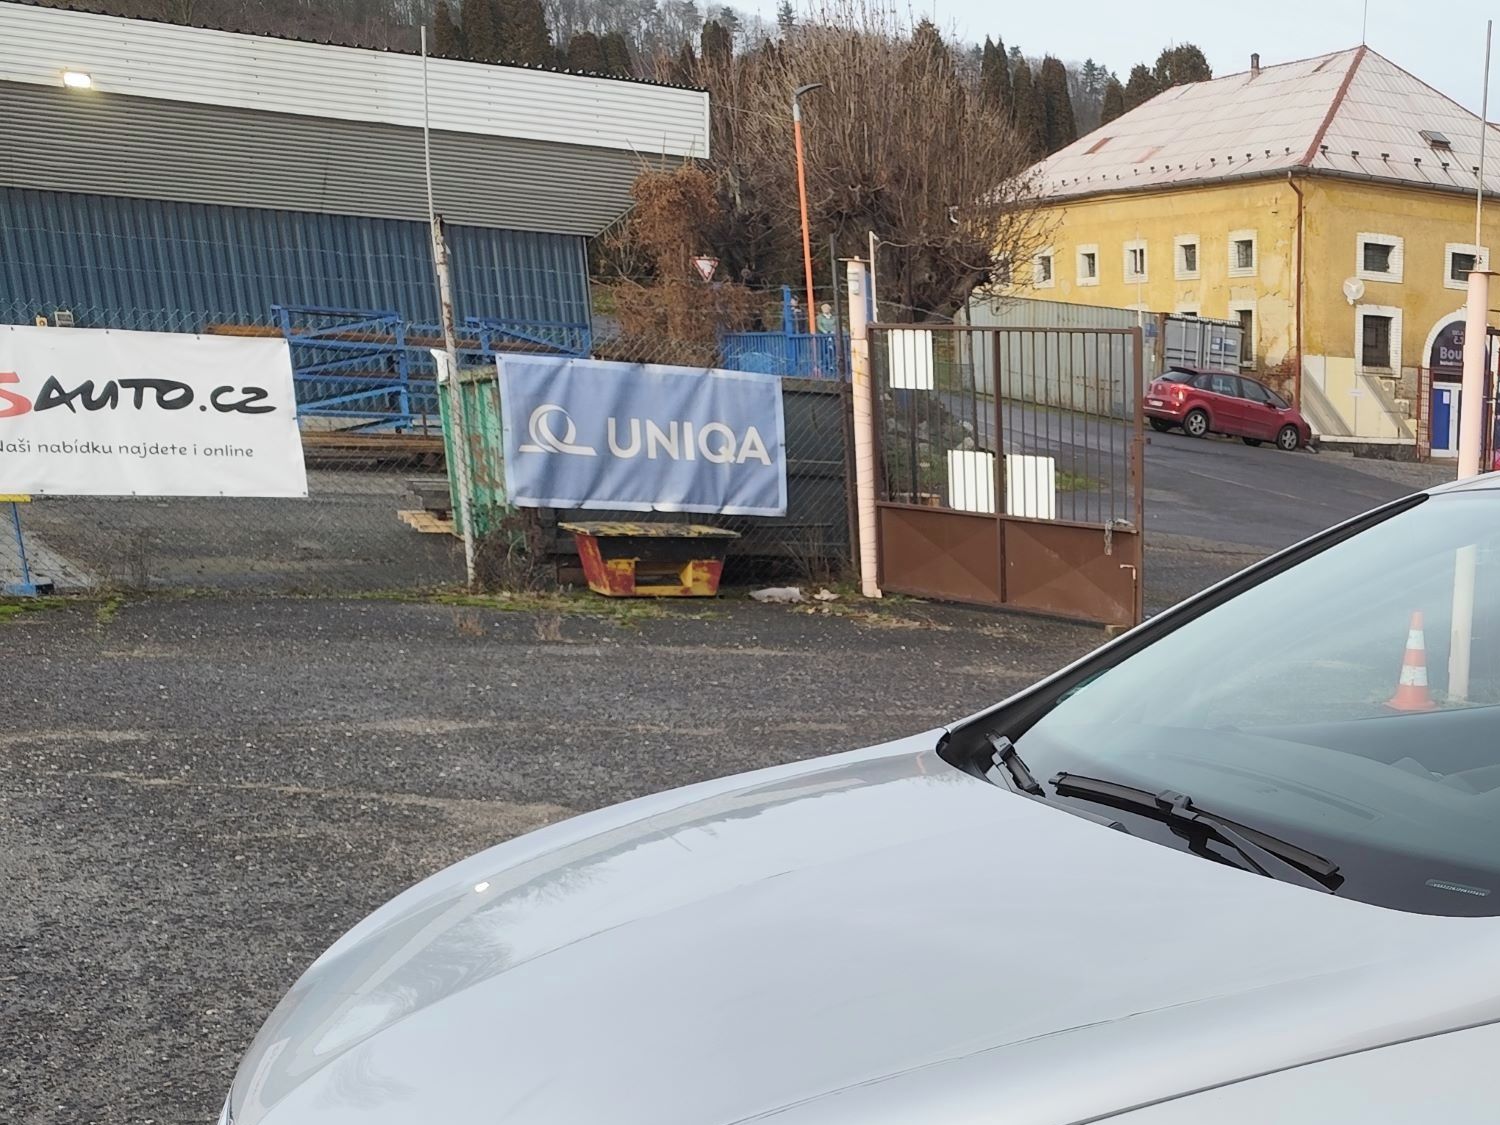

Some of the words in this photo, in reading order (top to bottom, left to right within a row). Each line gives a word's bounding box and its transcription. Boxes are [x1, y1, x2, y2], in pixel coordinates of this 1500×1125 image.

[1440, 346, 1463, 360] Bou
[38, 439, 113, 455] nabídku
[118, 441, 187, 459] najdete
[193, 443, 198, 456] i
[203, 445, 254, 458] online
[607, 417, 772, 466] UNIQA
